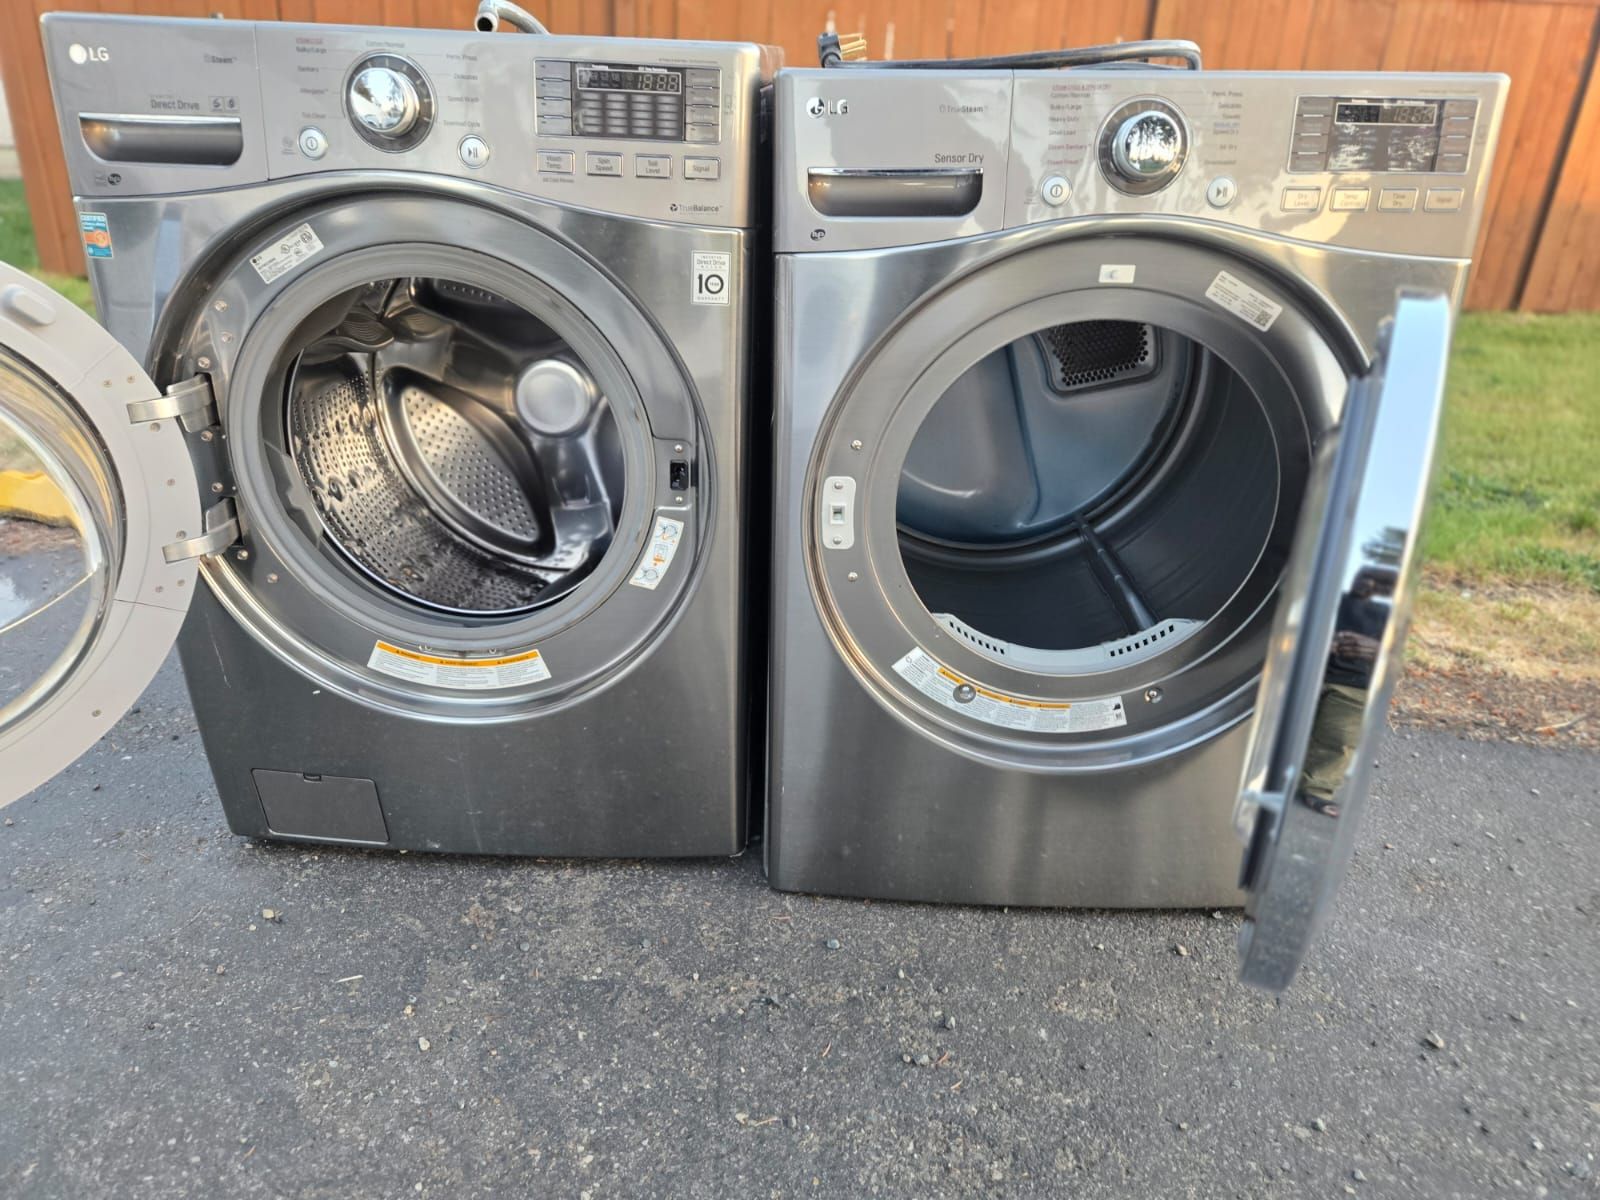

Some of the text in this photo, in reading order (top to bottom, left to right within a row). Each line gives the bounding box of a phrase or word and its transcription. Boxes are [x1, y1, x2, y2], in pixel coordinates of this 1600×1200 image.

[89, 46, 109, 62] LG
[150, 99, 200, 111] Direct Drive
[828, 99, 848, 115] LG
[934, 152, 985, 165] Sensor Dry
[697, 273, 725, 295] 10
